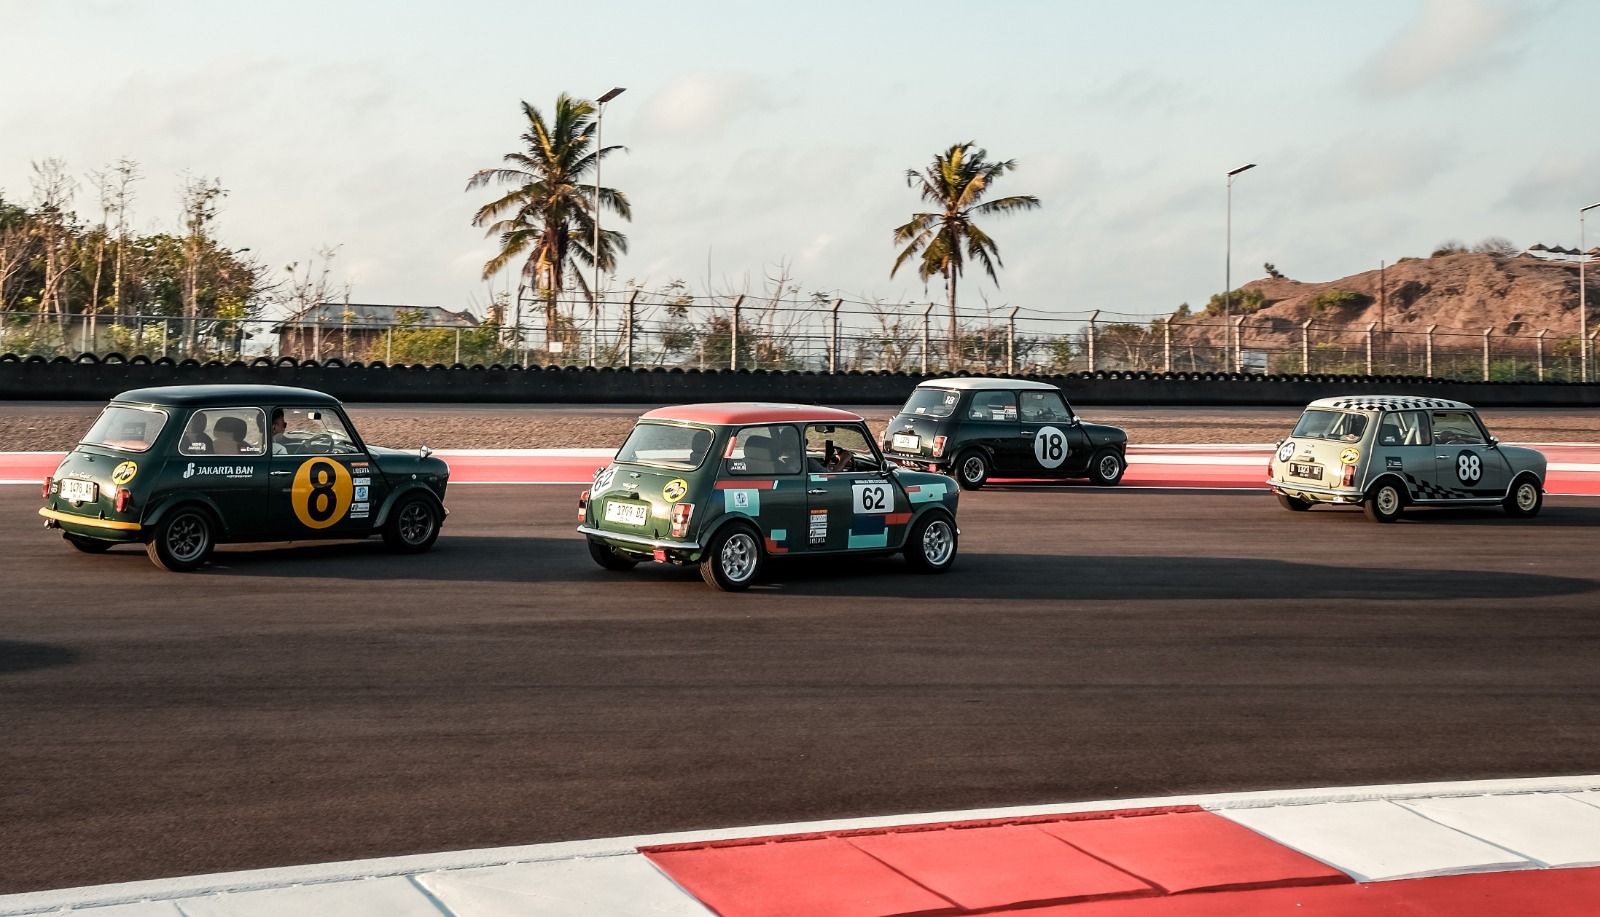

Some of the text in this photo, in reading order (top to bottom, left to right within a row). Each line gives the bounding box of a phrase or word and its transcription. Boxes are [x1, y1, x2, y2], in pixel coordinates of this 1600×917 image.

[944, 395, 956, 405] 18
[1039, 433, 1063, 461] 18
[197, 466, 254, 475] JAKARTA BAN
[1458, 454, 1481, 481] 88
[307, 461, 338, 522] 8
[594, 470, 614, 492] 62
[862, 487, 886, 511] 62
